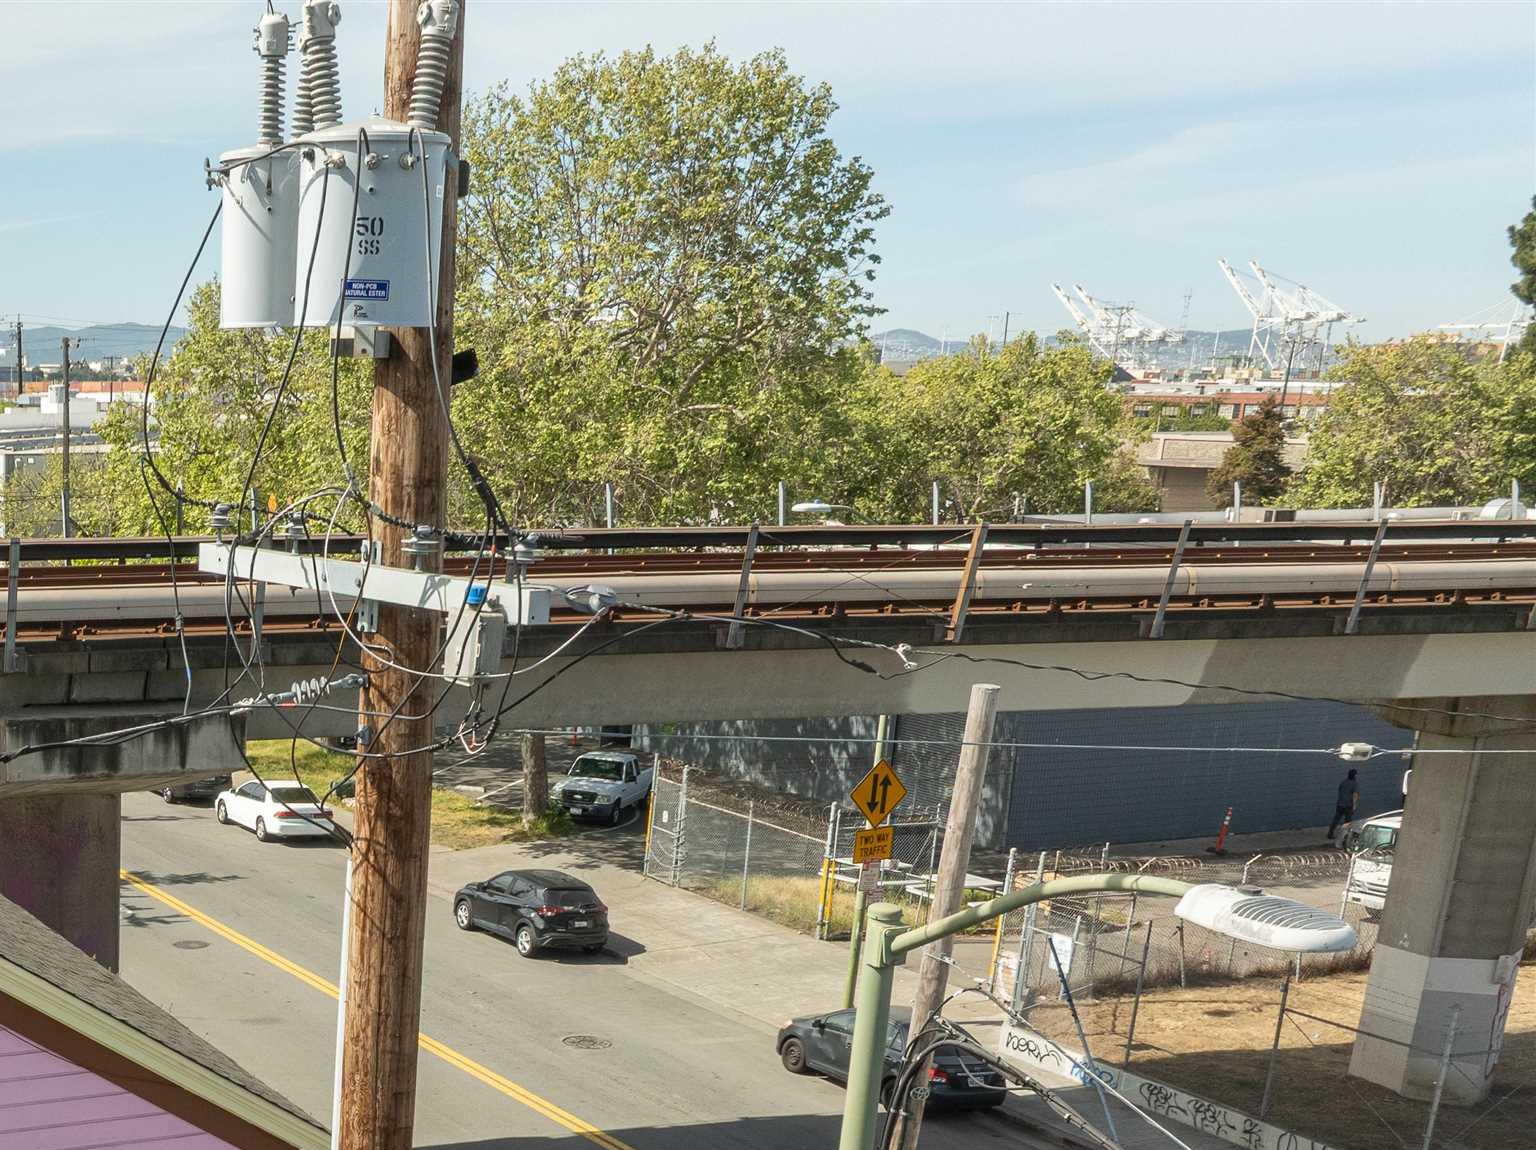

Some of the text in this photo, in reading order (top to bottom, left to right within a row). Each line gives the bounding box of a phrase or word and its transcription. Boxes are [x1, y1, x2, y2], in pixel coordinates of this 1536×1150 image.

[356, 216, 384, 237] 50
[358, 239, 380, 256] SS
[352, 282, 377, 290] NON-PCB
[368, 289, 386, 297] ESTER
[860, 832, 890, 845] TWO WAY
[860, 845, 888, 857] TRAFFIC
